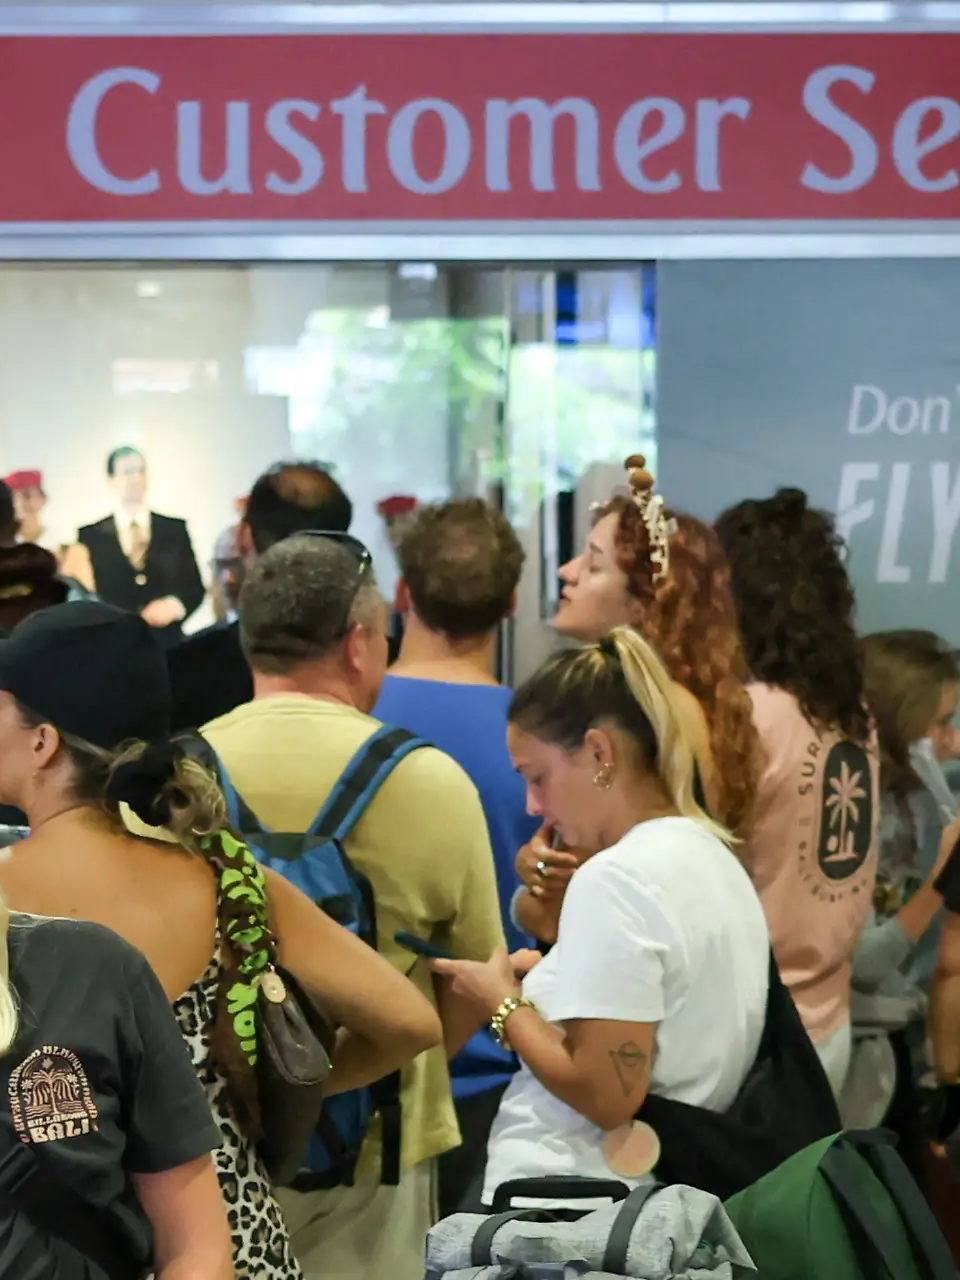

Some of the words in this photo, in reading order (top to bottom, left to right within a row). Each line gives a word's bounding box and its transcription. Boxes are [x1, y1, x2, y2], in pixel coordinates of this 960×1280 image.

[66, 66, 751, 196] Customer
[835, 461, 960, 583] FLY
[798, 742, 824, 797] SUR
[29, 1118, 90, 1143] BALI
